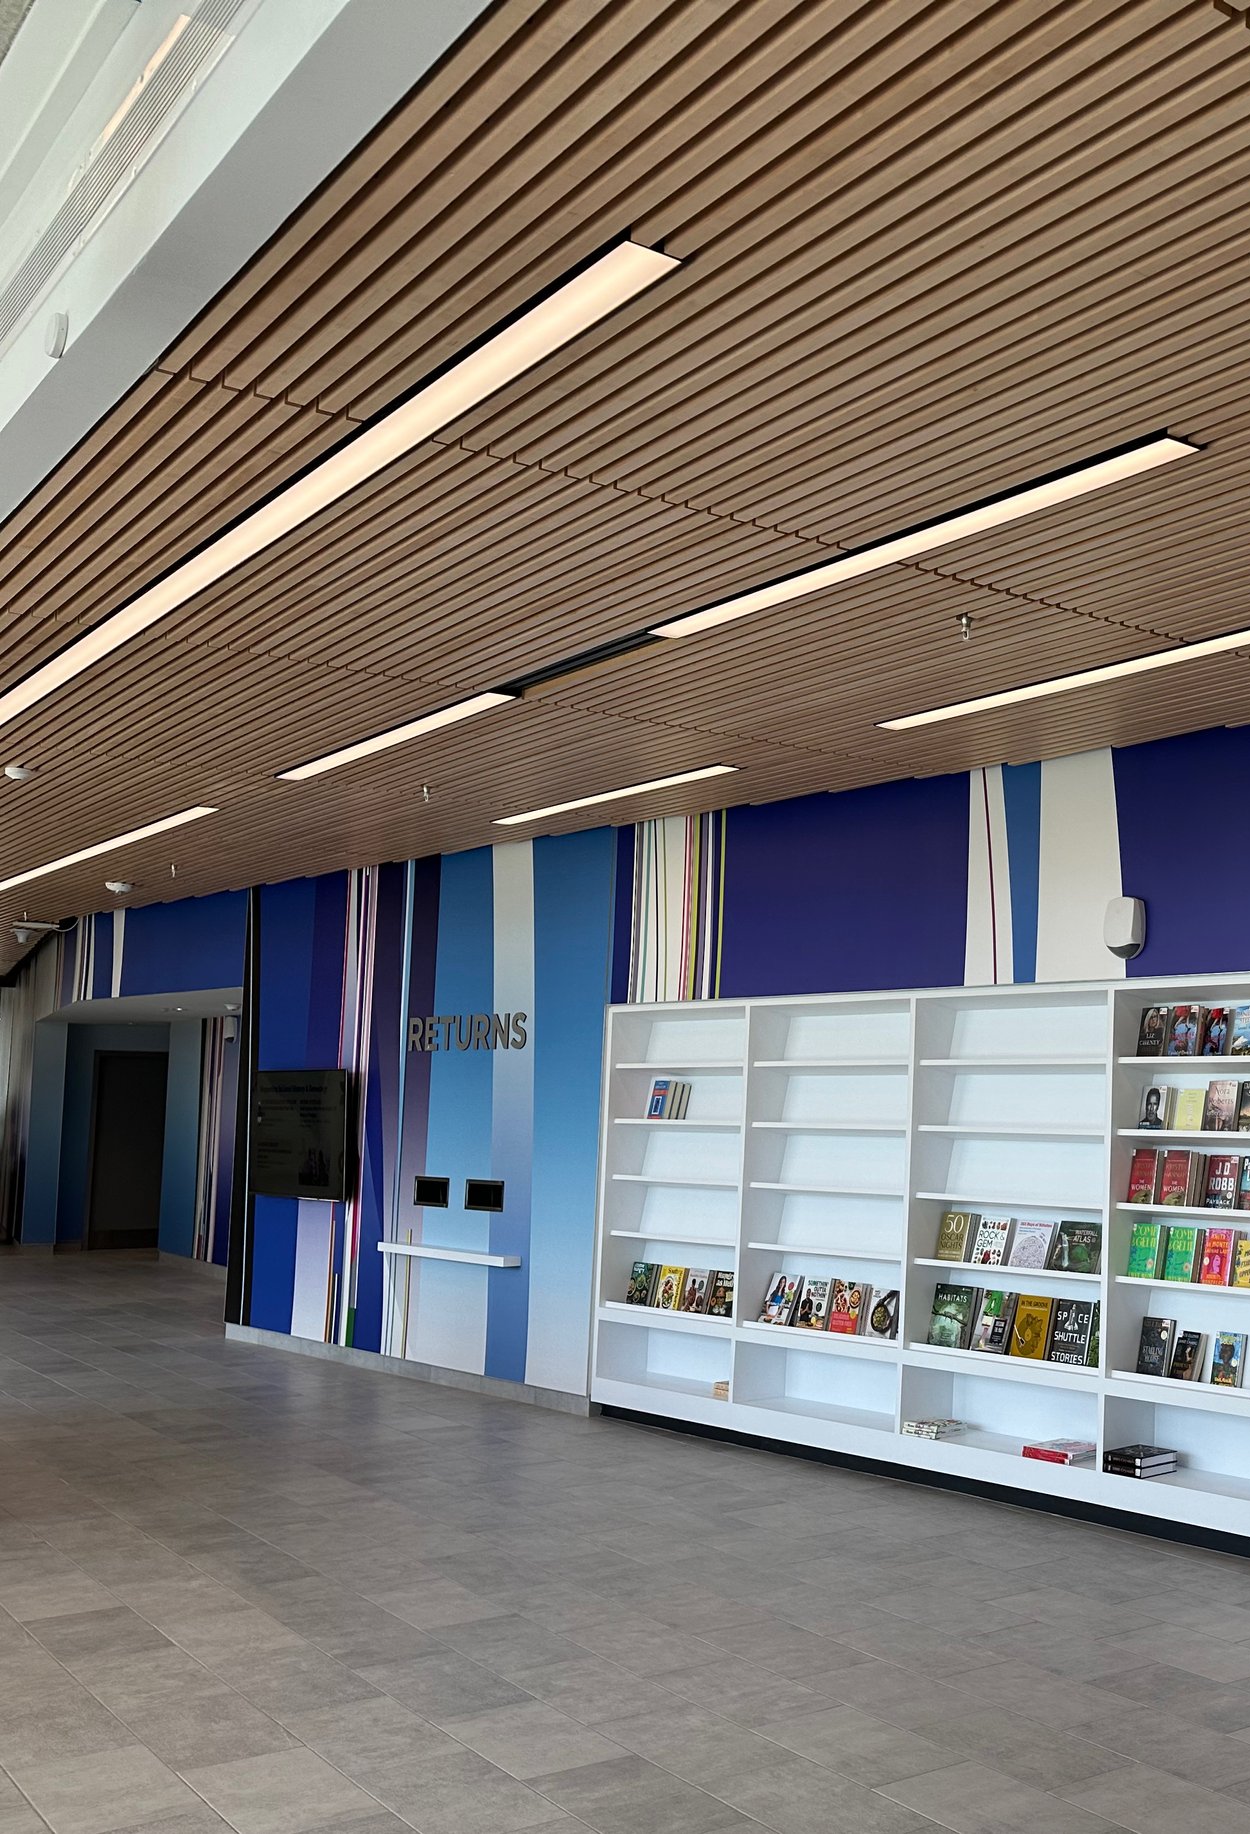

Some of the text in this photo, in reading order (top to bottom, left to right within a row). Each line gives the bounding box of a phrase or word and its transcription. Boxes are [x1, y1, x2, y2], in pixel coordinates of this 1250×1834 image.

[408, 1012, 527, 1052] RETURNS
[1131, 1183, 1152, 1191] WOMEN
[1163, 1185, 1185, 1193] WOMEN
[1208, 1177, 1235, 1191] ROBB
[944, 1214, 964, 1234] 50
[940, 1233, 964, 1242] OSCAR
[978, 1230, 1005, 1240] ROCK &
[1072, 1235, 1092, 1244] ATLAS
[940, 1241, 963, 1249] NIGHTS
[977, 1239, 993, 1248] GEM
[938, 1293, 968, 1303] HABITATS
[1054, 1331, 1086, 1344] SHUTTLE
[1051, 1351, 1084, 1365] STORIES
